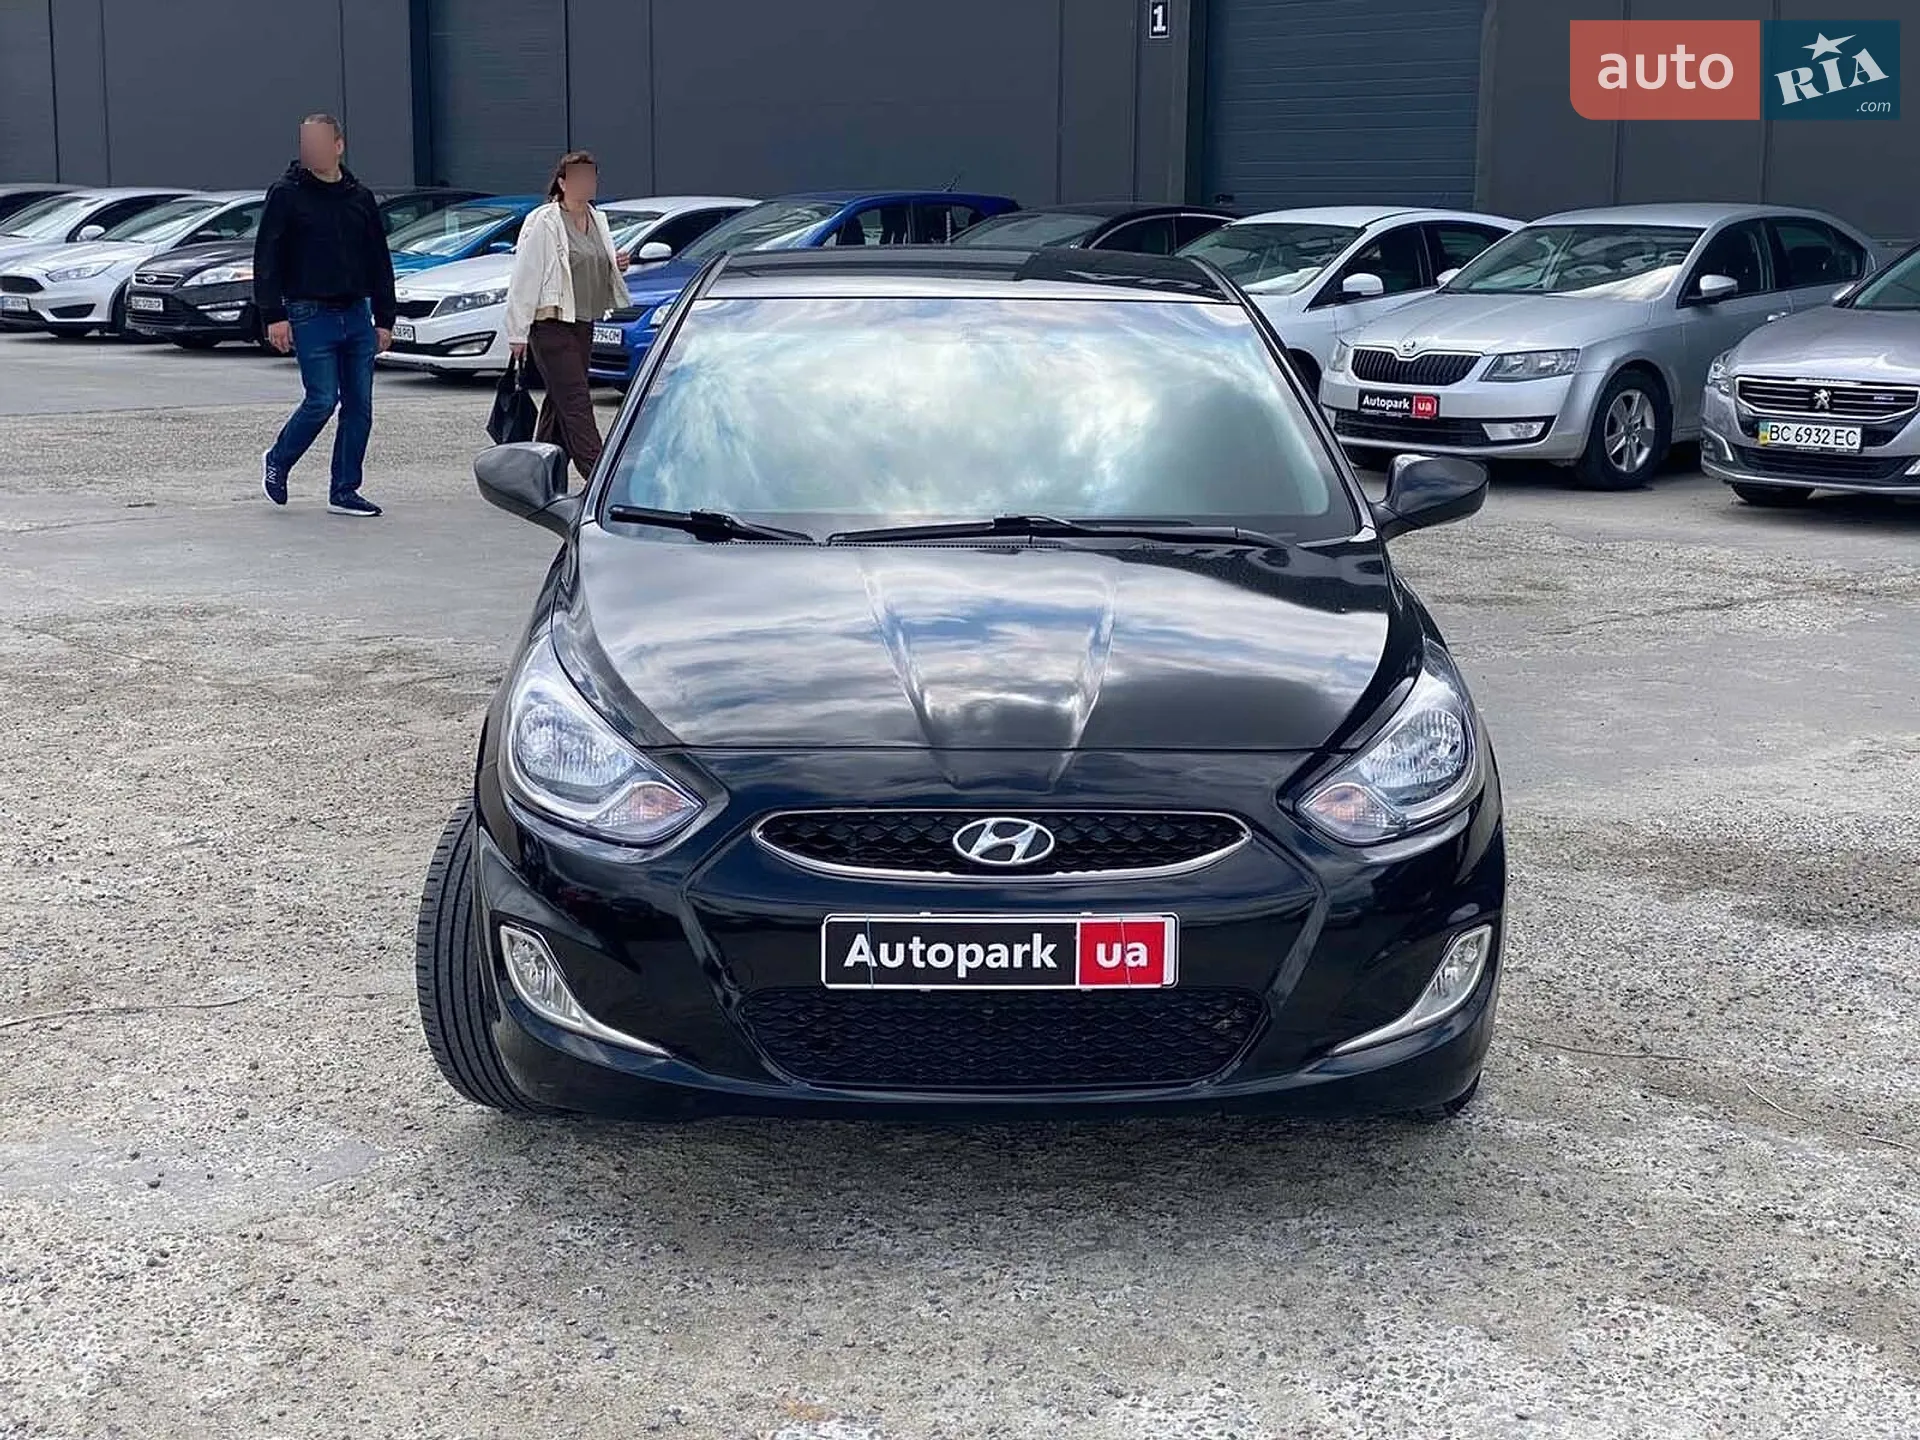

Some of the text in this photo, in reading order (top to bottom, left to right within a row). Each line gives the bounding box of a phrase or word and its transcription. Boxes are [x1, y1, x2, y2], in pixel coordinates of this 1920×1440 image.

[1153, 4, 1167, 32] 1
[1362, 394, 1432, 412] Autopark ua
[1770, 424, 1857, 446] BC 6932 EC
[843, 932, 1148, 979] Autopark ua
